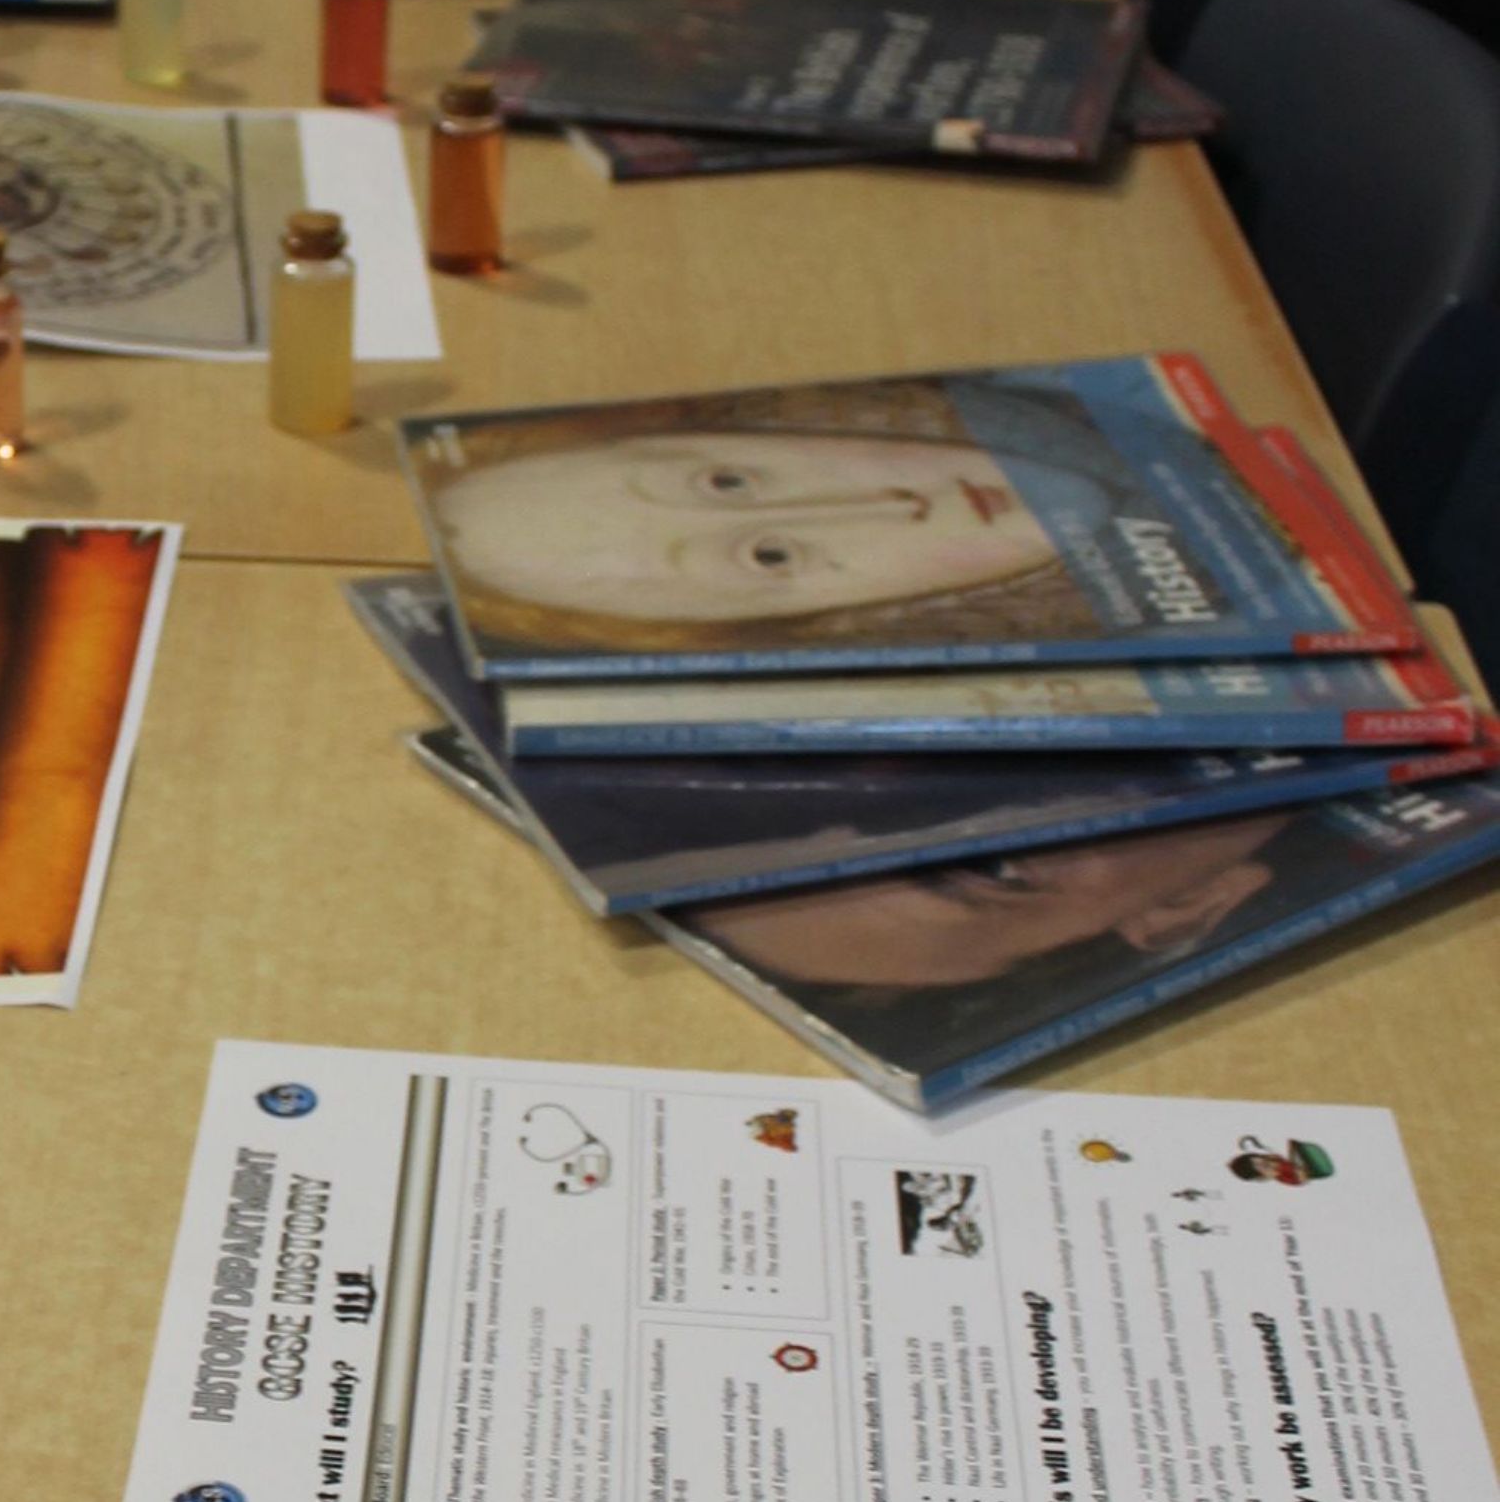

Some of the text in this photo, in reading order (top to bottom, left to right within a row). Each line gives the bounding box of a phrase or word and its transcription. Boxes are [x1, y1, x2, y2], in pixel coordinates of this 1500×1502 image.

[1113, 516, 1219, 624] History
[1307, 632, 1399, 650] PEARSON
[1360, 714, 1456, 734] PEARSON
[188, 1145, 278, 1423] HISTORY DEPARTMENT
[256, 1172, 332, 1401] GCSE HISTORY
[1022, 1290, 1060, 1402] developing?
[1250, 1311, 1294, 1406] assessed?
[327, 1359, 360, 1428] study?
[322, 1433, 348, 1443] I
[1038, 1406, 1064, 1431] be
[1274, 1411, 1300, 1435] be
[1040, 1435, 1066, 1444] I
[318, 1447, 346, 1486] will
[1041, 1448, 1071, 1484] will
[1278, 1440, 1312, 1490] work
